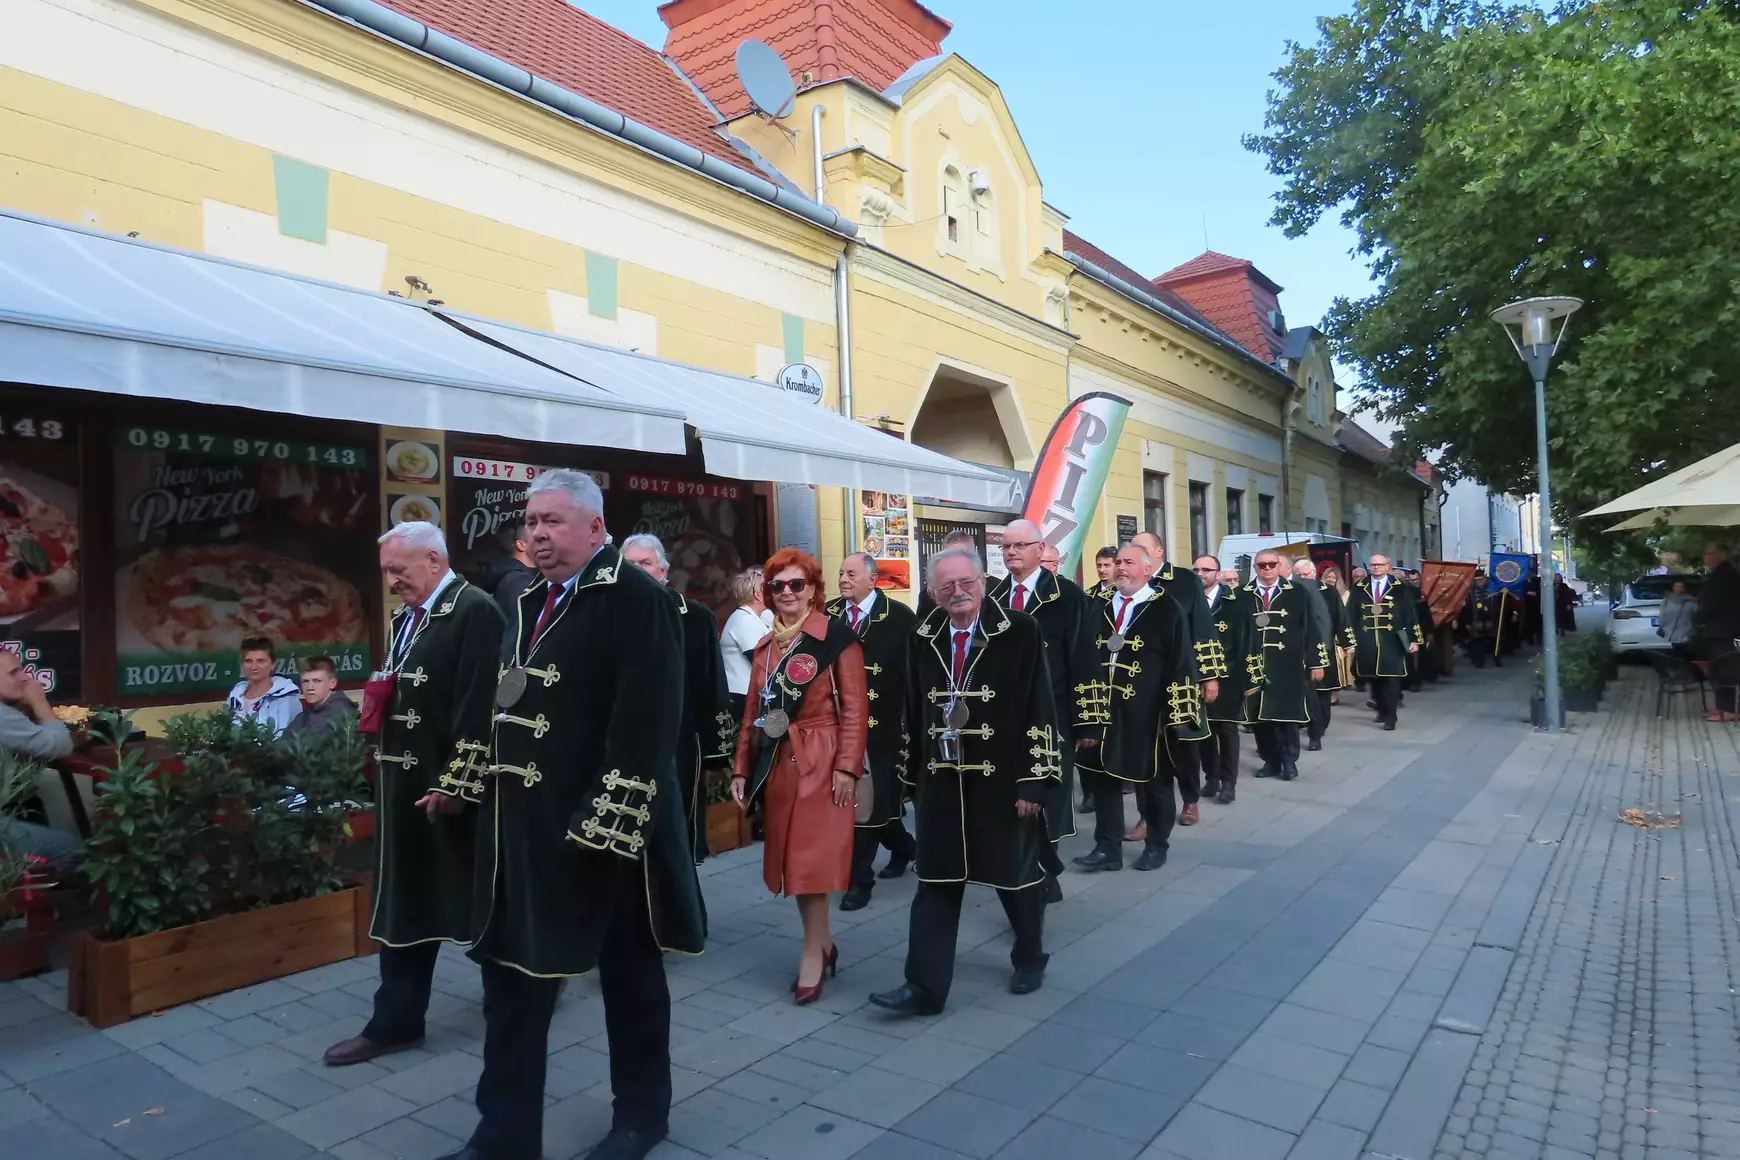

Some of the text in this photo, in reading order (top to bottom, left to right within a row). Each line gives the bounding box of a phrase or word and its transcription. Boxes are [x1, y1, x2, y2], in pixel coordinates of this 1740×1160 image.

[786, 377, 820, 396] Krombacher
[128, 428, 356, 465] 0917 970 143
[153, 464, 244, 487] New York
[461, 460, 514, 477] 0917
[475, 488, 504, 506] New
[630, 477, 737, 498] 0917 970 143
[130, 487, 258, 543] Pizza
[126, 662, 217, 686] ROZVOZ
